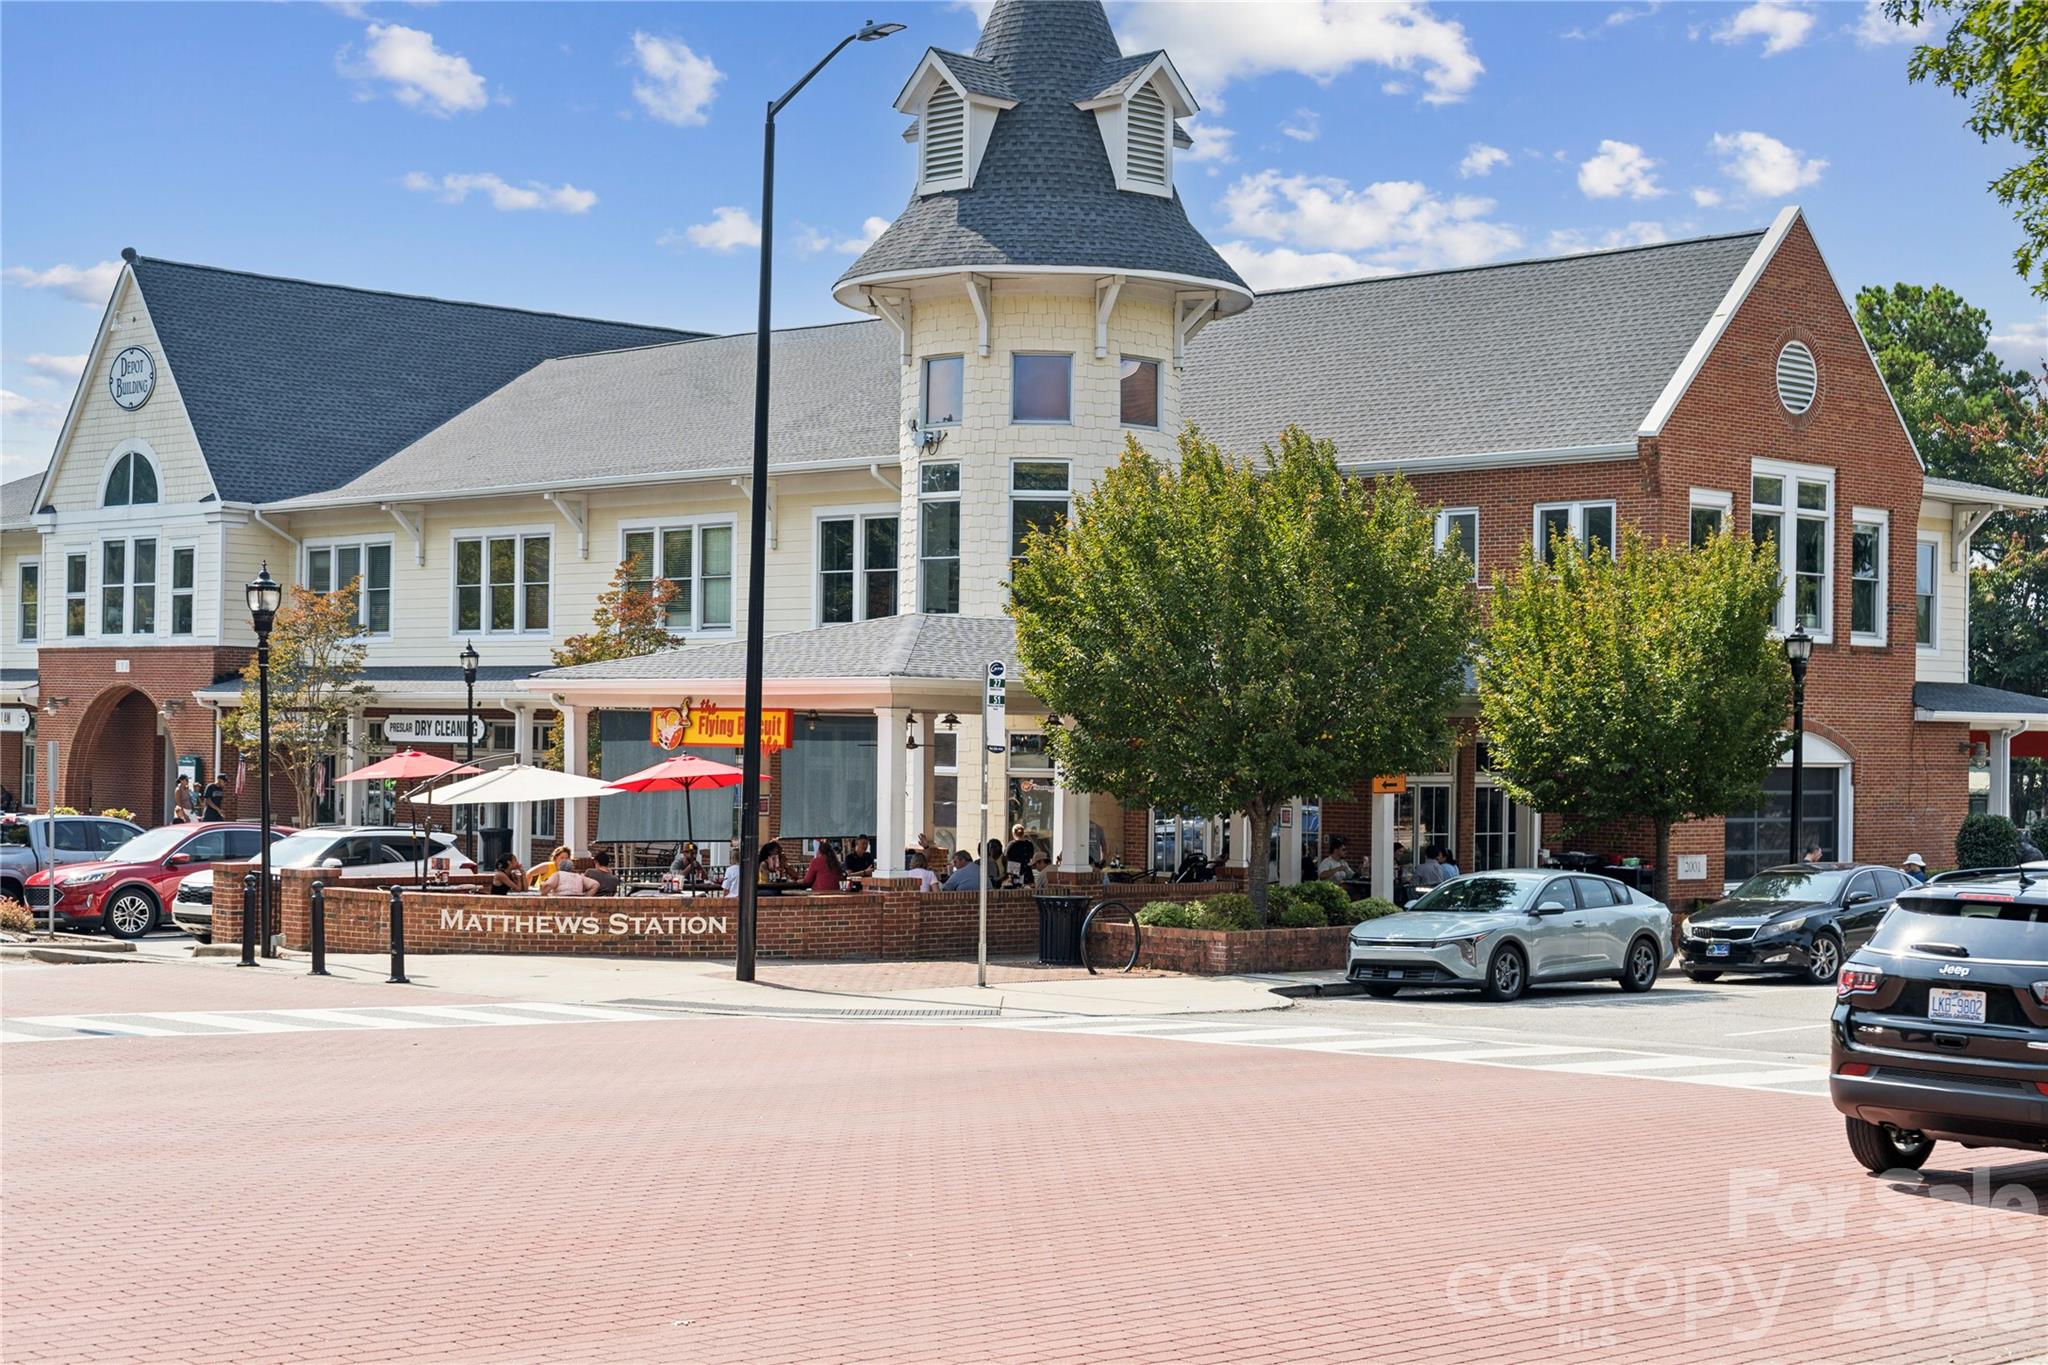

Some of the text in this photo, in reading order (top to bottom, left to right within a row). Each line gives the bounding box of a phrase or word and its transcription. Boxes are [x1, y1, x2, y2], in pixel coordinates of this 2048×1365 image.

[700, 699, 716, 715] the
[389, 722, 413, 733] PRESLAR
[414, 720, 432, 736] DRY
[698, 714, 734, 737] Flying
[440, 908, 727, 935] MATTHEWS STATION
[1939, 964, 1970, 977] Jeep
